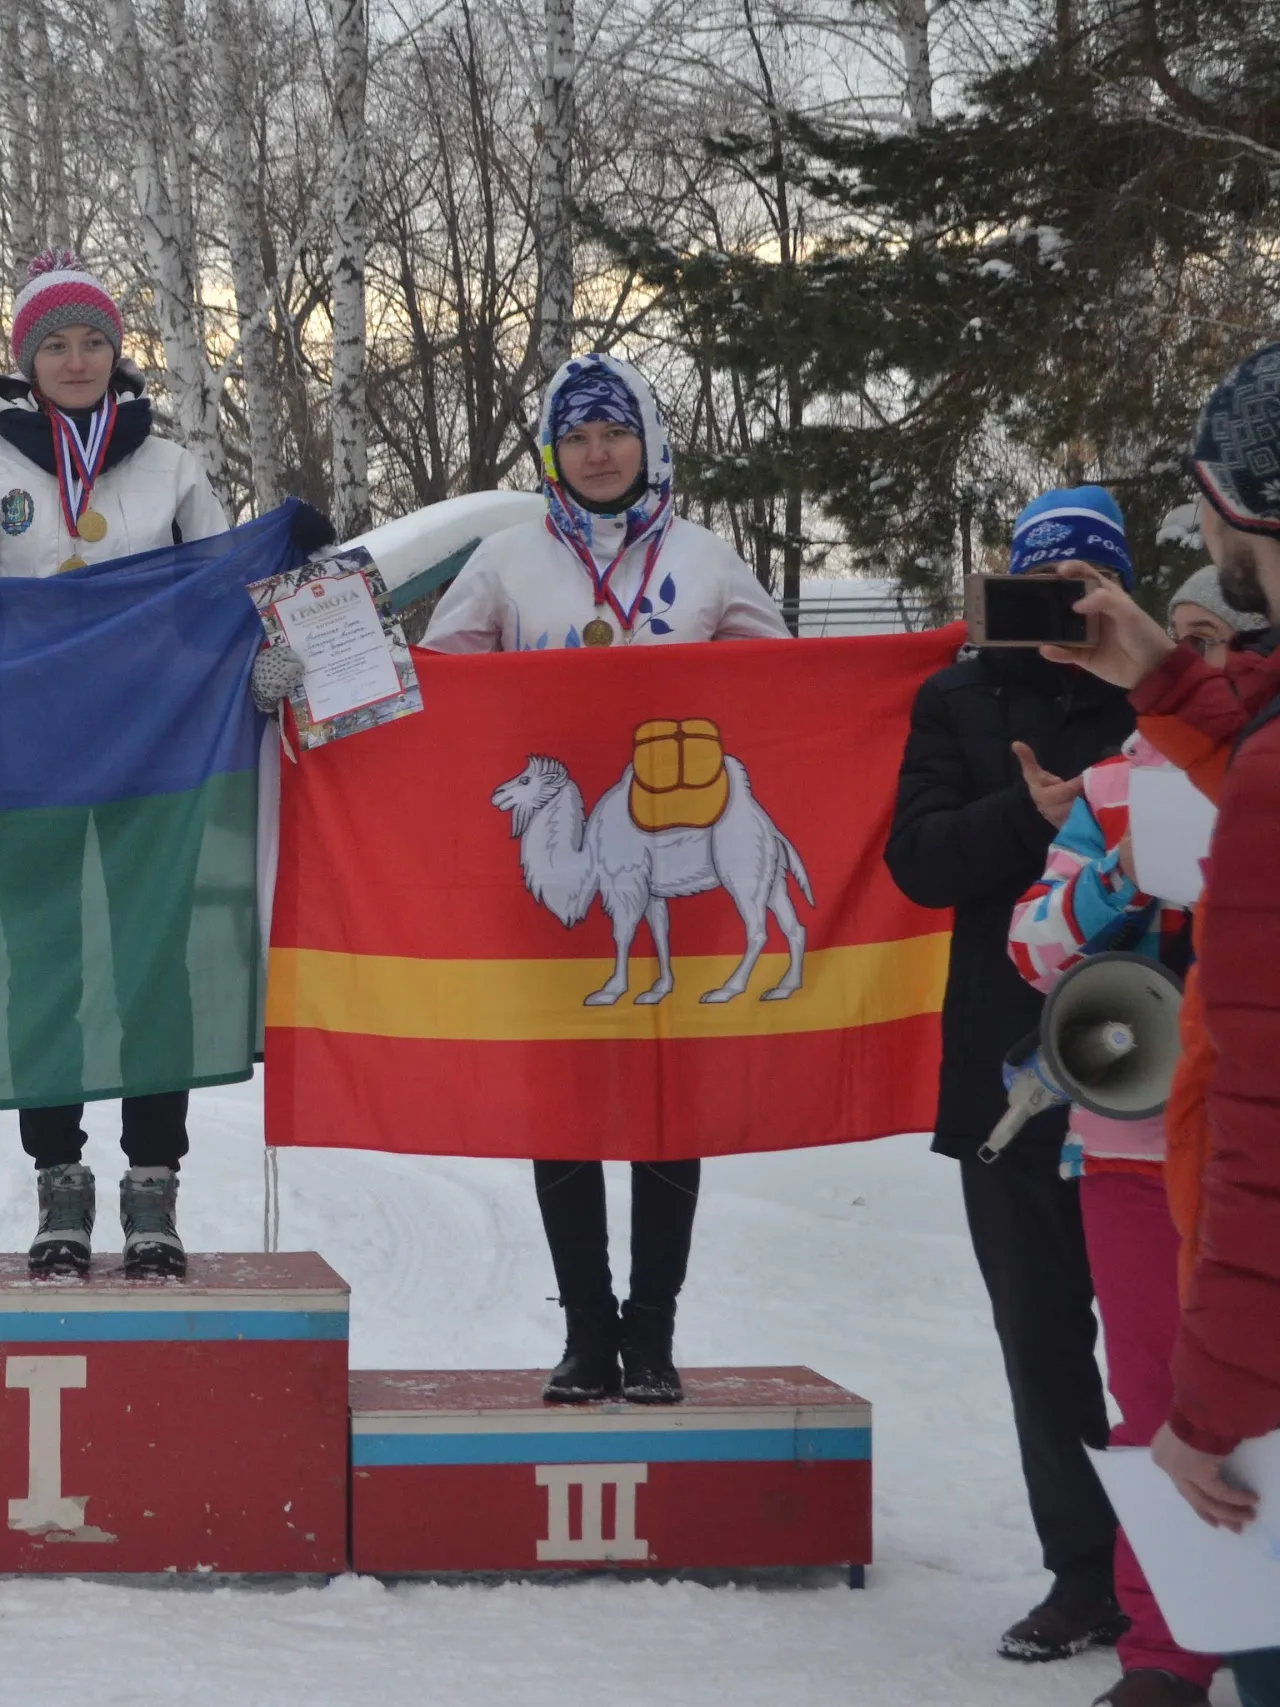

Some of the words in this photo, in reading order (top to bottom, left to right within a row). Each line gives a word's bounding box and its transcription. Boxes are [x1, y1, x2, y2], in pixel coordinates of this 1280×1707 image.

[1019, 547, 1077, 569] 2014
[289, 591, 361, 622] ГРАМОТА
[5, 1355, 88, 1533] I
[535, 1463, 649, 1562] III
